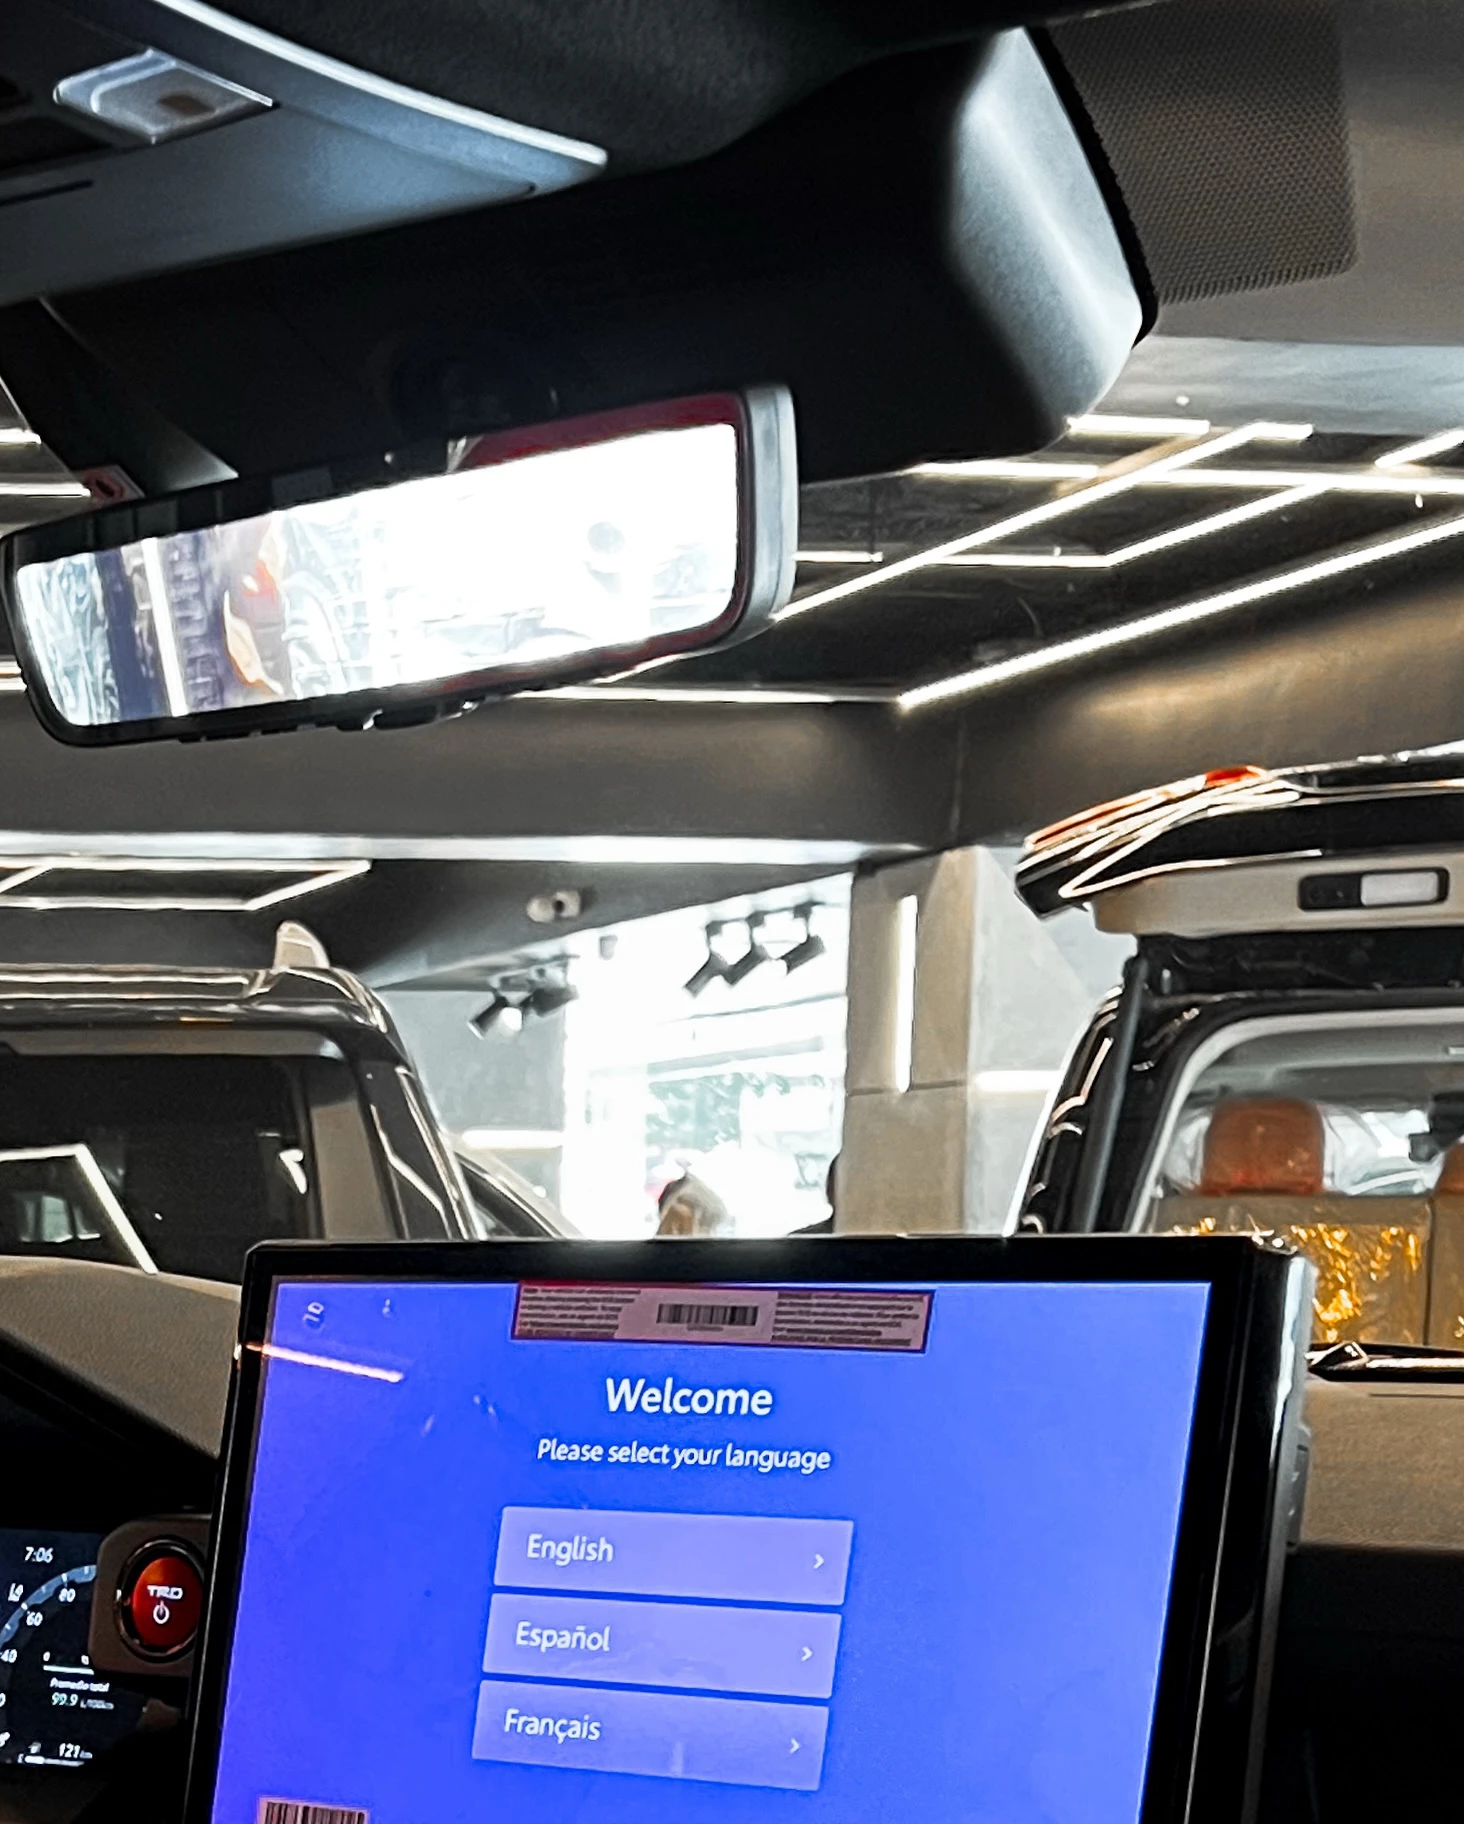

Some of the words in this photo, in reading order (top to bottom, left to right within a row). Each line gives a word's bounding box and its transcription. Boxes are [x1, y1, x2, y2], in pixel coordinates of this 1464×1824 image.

[605, 1376, 774, 1416] Welcome
[537, 1438, 603, 1462] Please
[608, 1440, 669, 1464] select
[671, 1446, 720, 1470] your
[725, 1442, 832, 1475] language
[24, 1546, 54, 1563] 7:06
[526, 1533, 614, 1567] English
[147, 1585, 184, 1600] TRD
[26, 1611, 43, 1627] 60
[515, 1620, 611, 1653] Español
[0, 1649, 18, 1663] 40
[504, 1708, 601, 1745] Français
